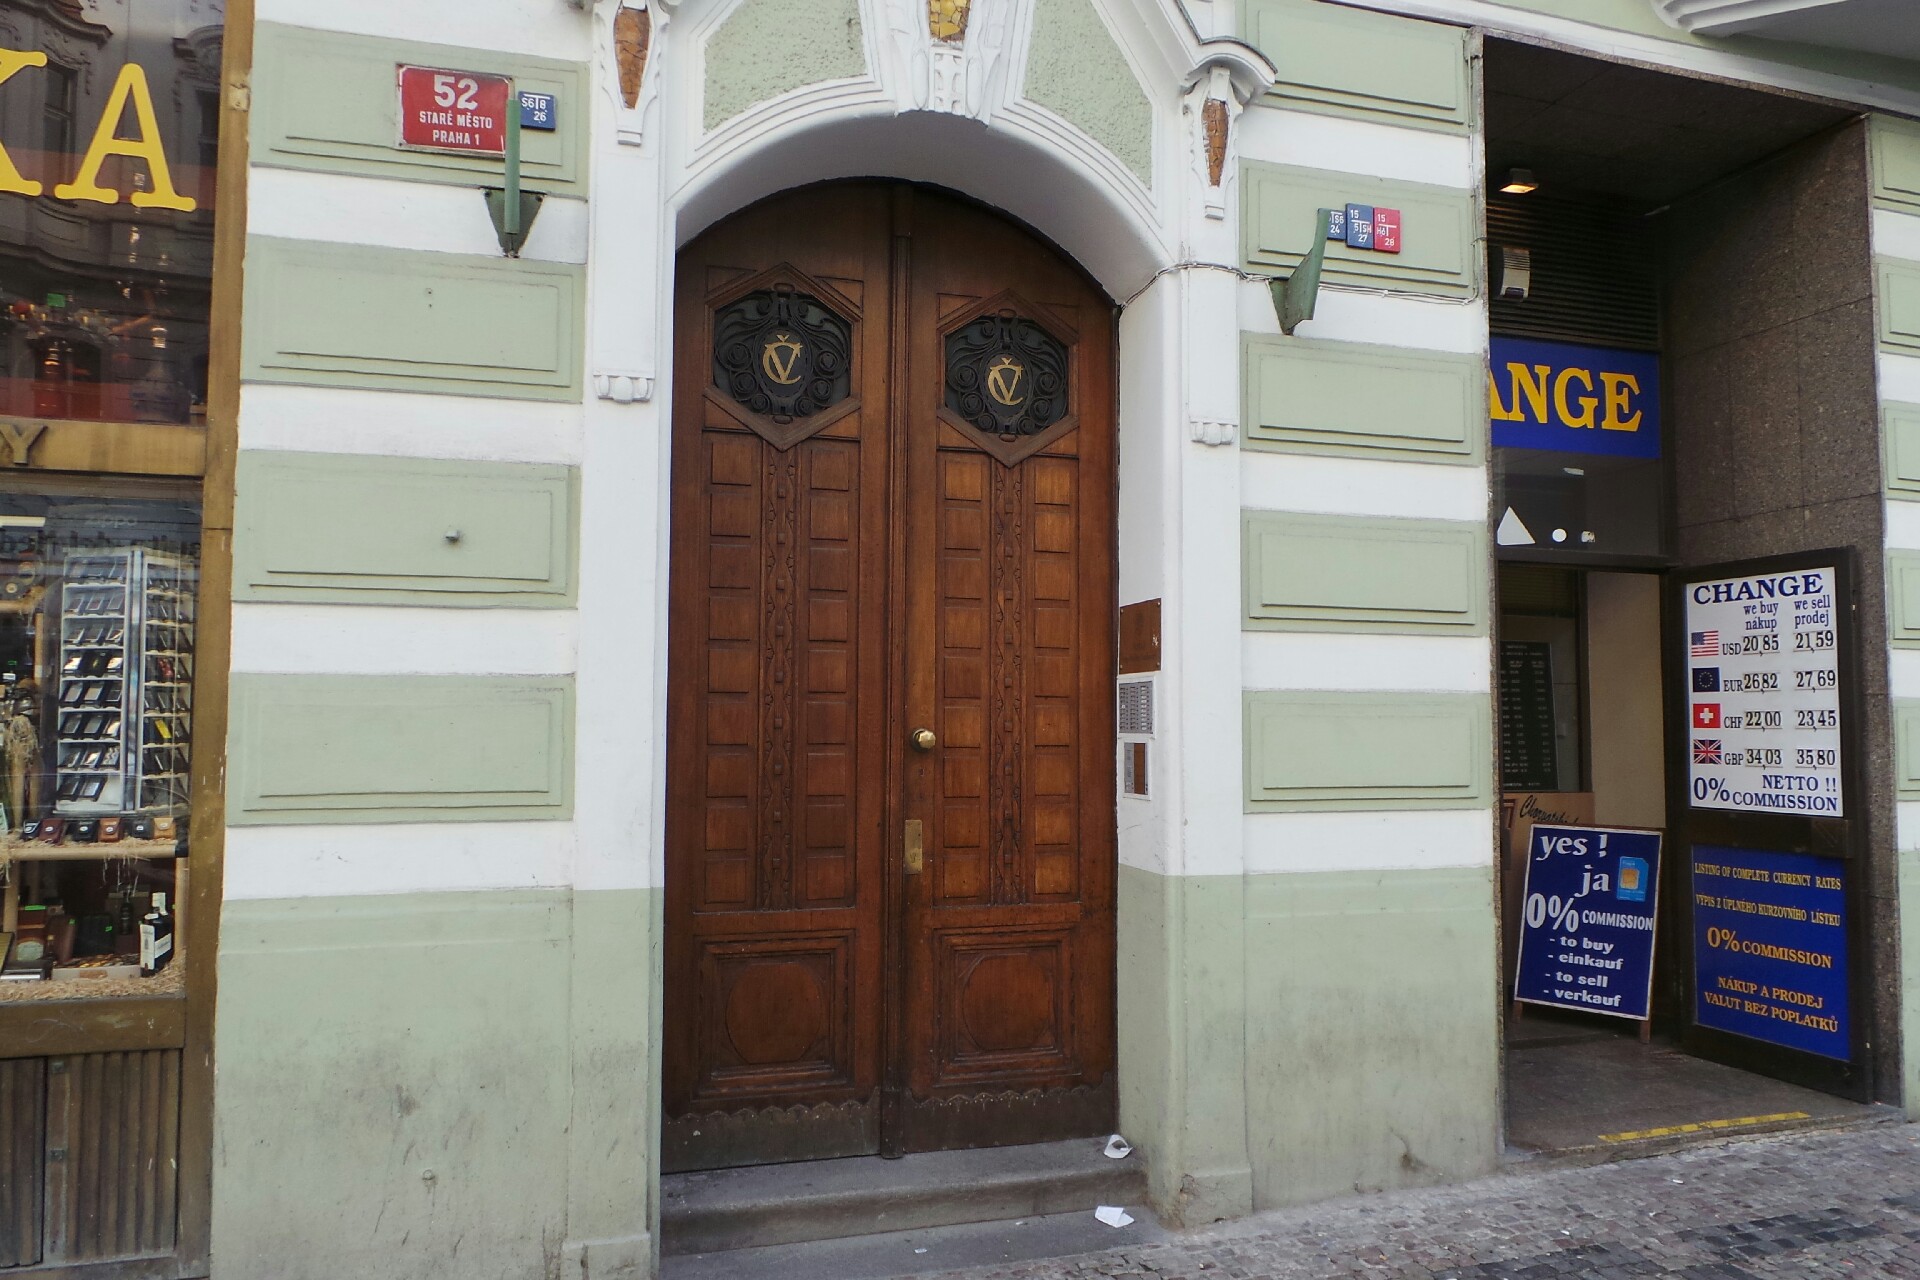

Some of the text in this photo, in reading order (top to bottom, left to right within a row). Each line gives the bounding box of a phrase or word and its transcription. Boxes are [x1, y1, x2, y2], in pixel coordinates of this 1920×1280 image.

[434, 74, 478, 110] 52
[419, 110, 493, 129] STARÉ MĚSTO
[533, 111, 547, 121] 26
[432, 129, 480, 145] PRAHA 1
[1350, 209, 1359, 219] 15
[1377, 214, 1386, 222] 15
[1330, 225, 1340, 233] 24
[1358, 234, 1368, 243] 27
[1384, 237, 1395, 246] 28
[1693, 573, 1824, 605] CHANGE
[1743, 601, 1779, 617] we buy
[1794, 594, 1831, 611] we sell
[1745, 616, 1777, 632] nákup
[1794, 609, 1830, 629] prodej
[1722, 643, 1742, 655] USD
[1723, 679, 1743, 691] EUR
[1723, 716, 1743, 729] CHF
[1724, 752, 1744, 765] GBP
[1762, 774, 1837, 792] NETTO !!
[1693, 776, 1838, 812] 0% COMMISSION
[1536, 834, 1608, 861] yes !
[1574, 864, 1611, 898] ja
[1695, 862, 1842, 890] LISTING OF COMPLETE CURRENCY RATES
[1526, 893, 1654, 933] 0% COMMISSION
[1695, 892, 1841, 926] VÝPIS Z ÚPLNÉHO KURZOVNÍHO LÍSTKU
[1560, 936, 1578, 947] to
[1582, 937, 1614, 955] buy
[1707, 926, 1832, 968] 0% COMMISSION
[1558, 952, 1624, 970] einkauf
[1556, 971, 1573, 983] to
[1577, 974, 1609, 988] sell
[1554, 989, 1622, 1007] verkauf
[1718, 975, 1823, 1009] NÁKUP A PRODEJ
[1704, 992, 1839, 1032] VALUT BEZ POPLATKŮ
